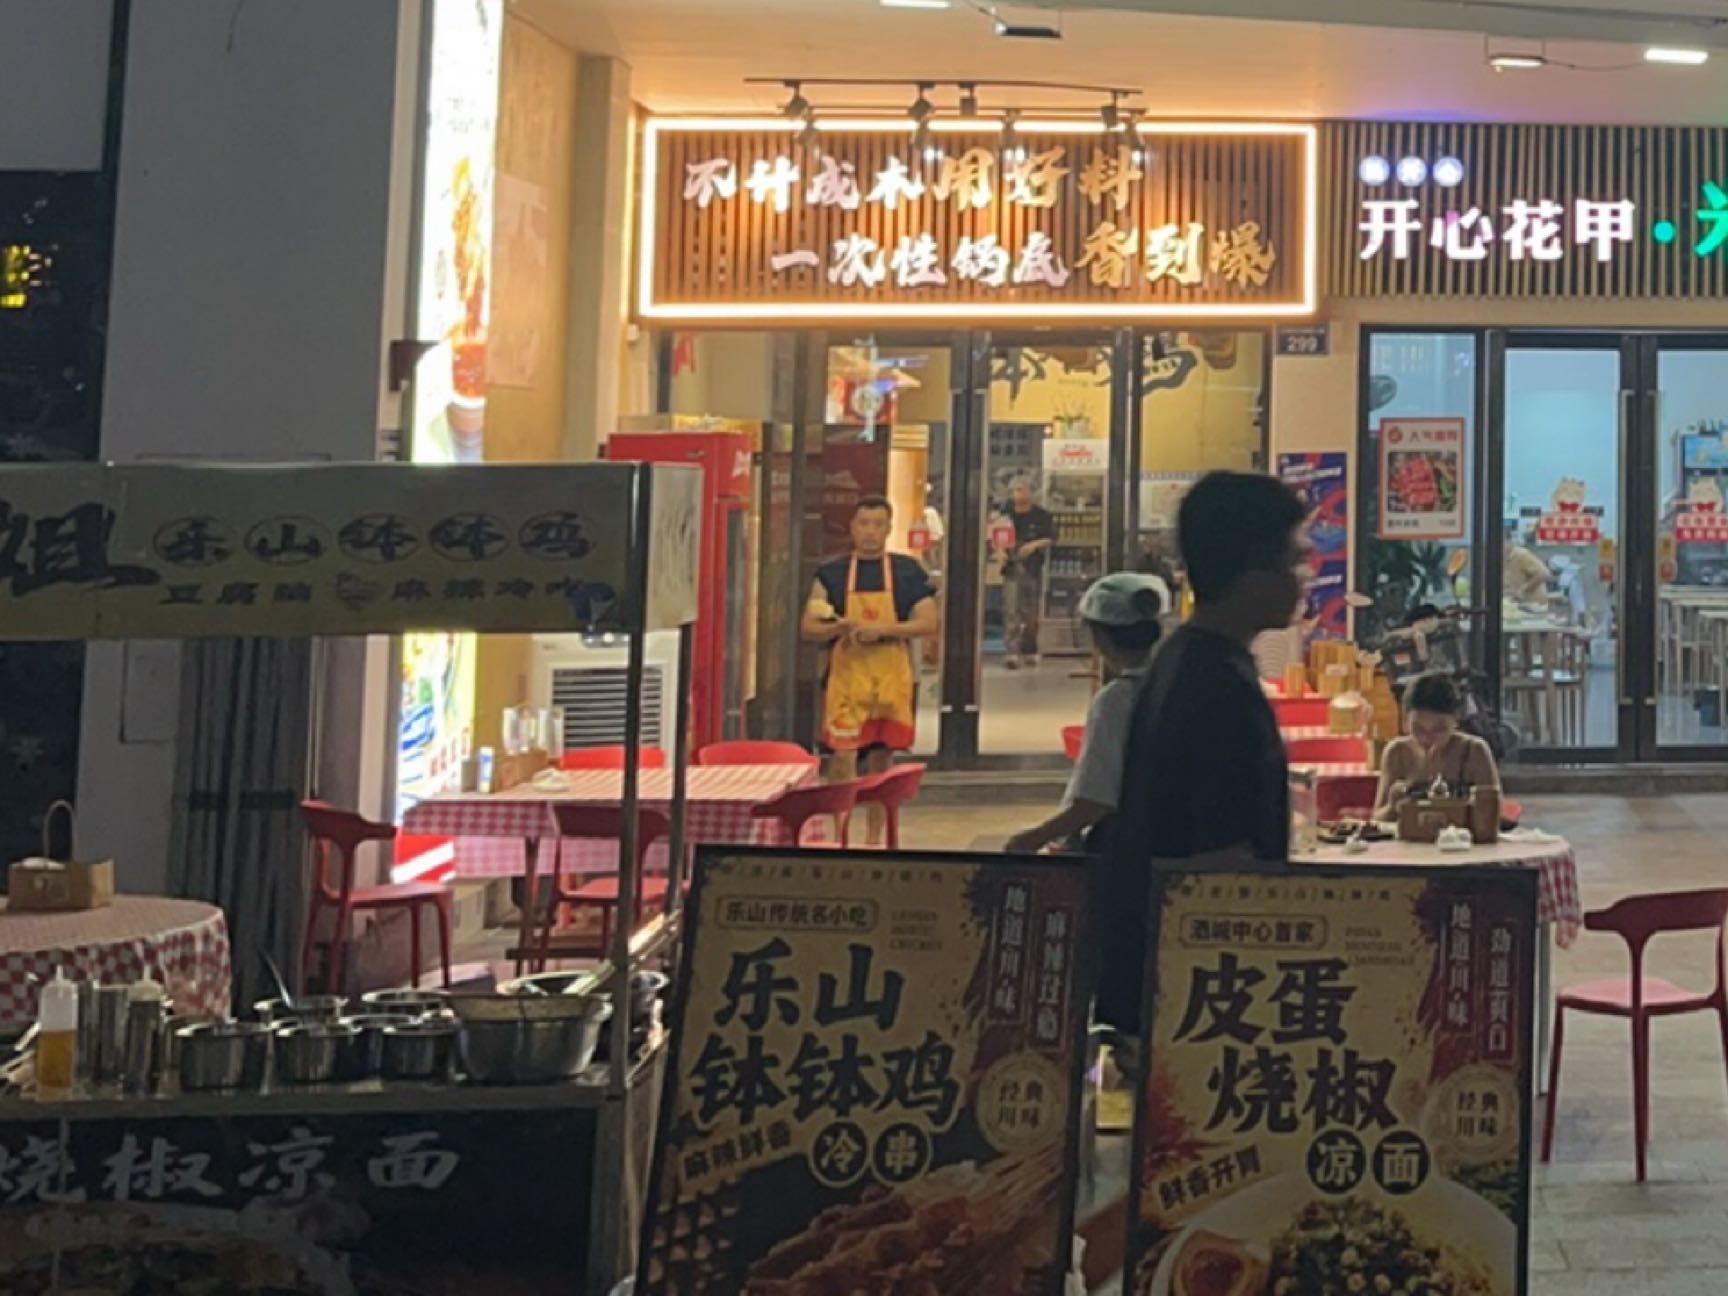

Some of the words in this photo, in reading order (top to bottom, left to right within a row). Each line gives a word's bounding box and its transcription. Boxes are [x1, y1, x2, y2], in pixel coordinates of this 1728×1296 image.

[684, 143, 1144, 211] 不计成本用好料
[771, 221, 1278, 289] 一次性锅底香到爆
[1286, 335, 1318, 353] 299
[162, 511, 594, 562] 乐山钵钵鸡
[713, 936, 905, 1031] 乐山
[1171, 951, 1358, 1046] 皮蛋
[689, 1031, 961, 1126] 钵钵鸡
[1203, 1045, 1400, 1135] 烧椒
[0, 1126, 460, 1205] 烧椒凉面
[817, 1125, 921, 1176] 冷串
[1314, 1139, 1424, 1189] 凉面
